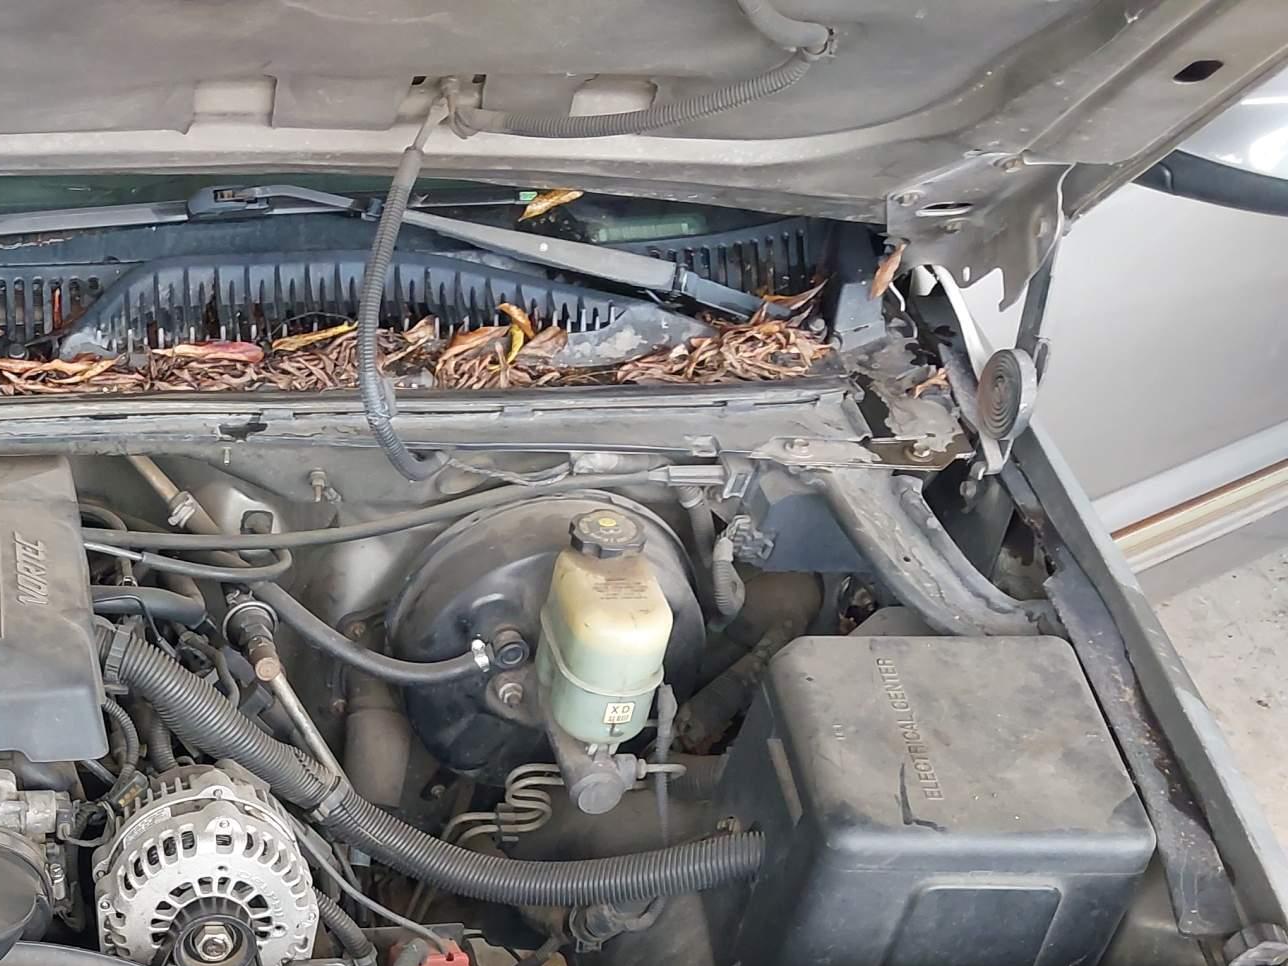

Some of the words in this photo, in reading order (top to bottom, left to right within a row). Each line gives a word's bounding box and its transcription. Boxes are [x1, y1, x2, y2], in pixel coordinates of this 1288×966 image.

[12, 530, 49, 606] VORTEC
[875, 656, 910, 712] CENTER
[896, 713, 945, 801] ELECTRICAL
